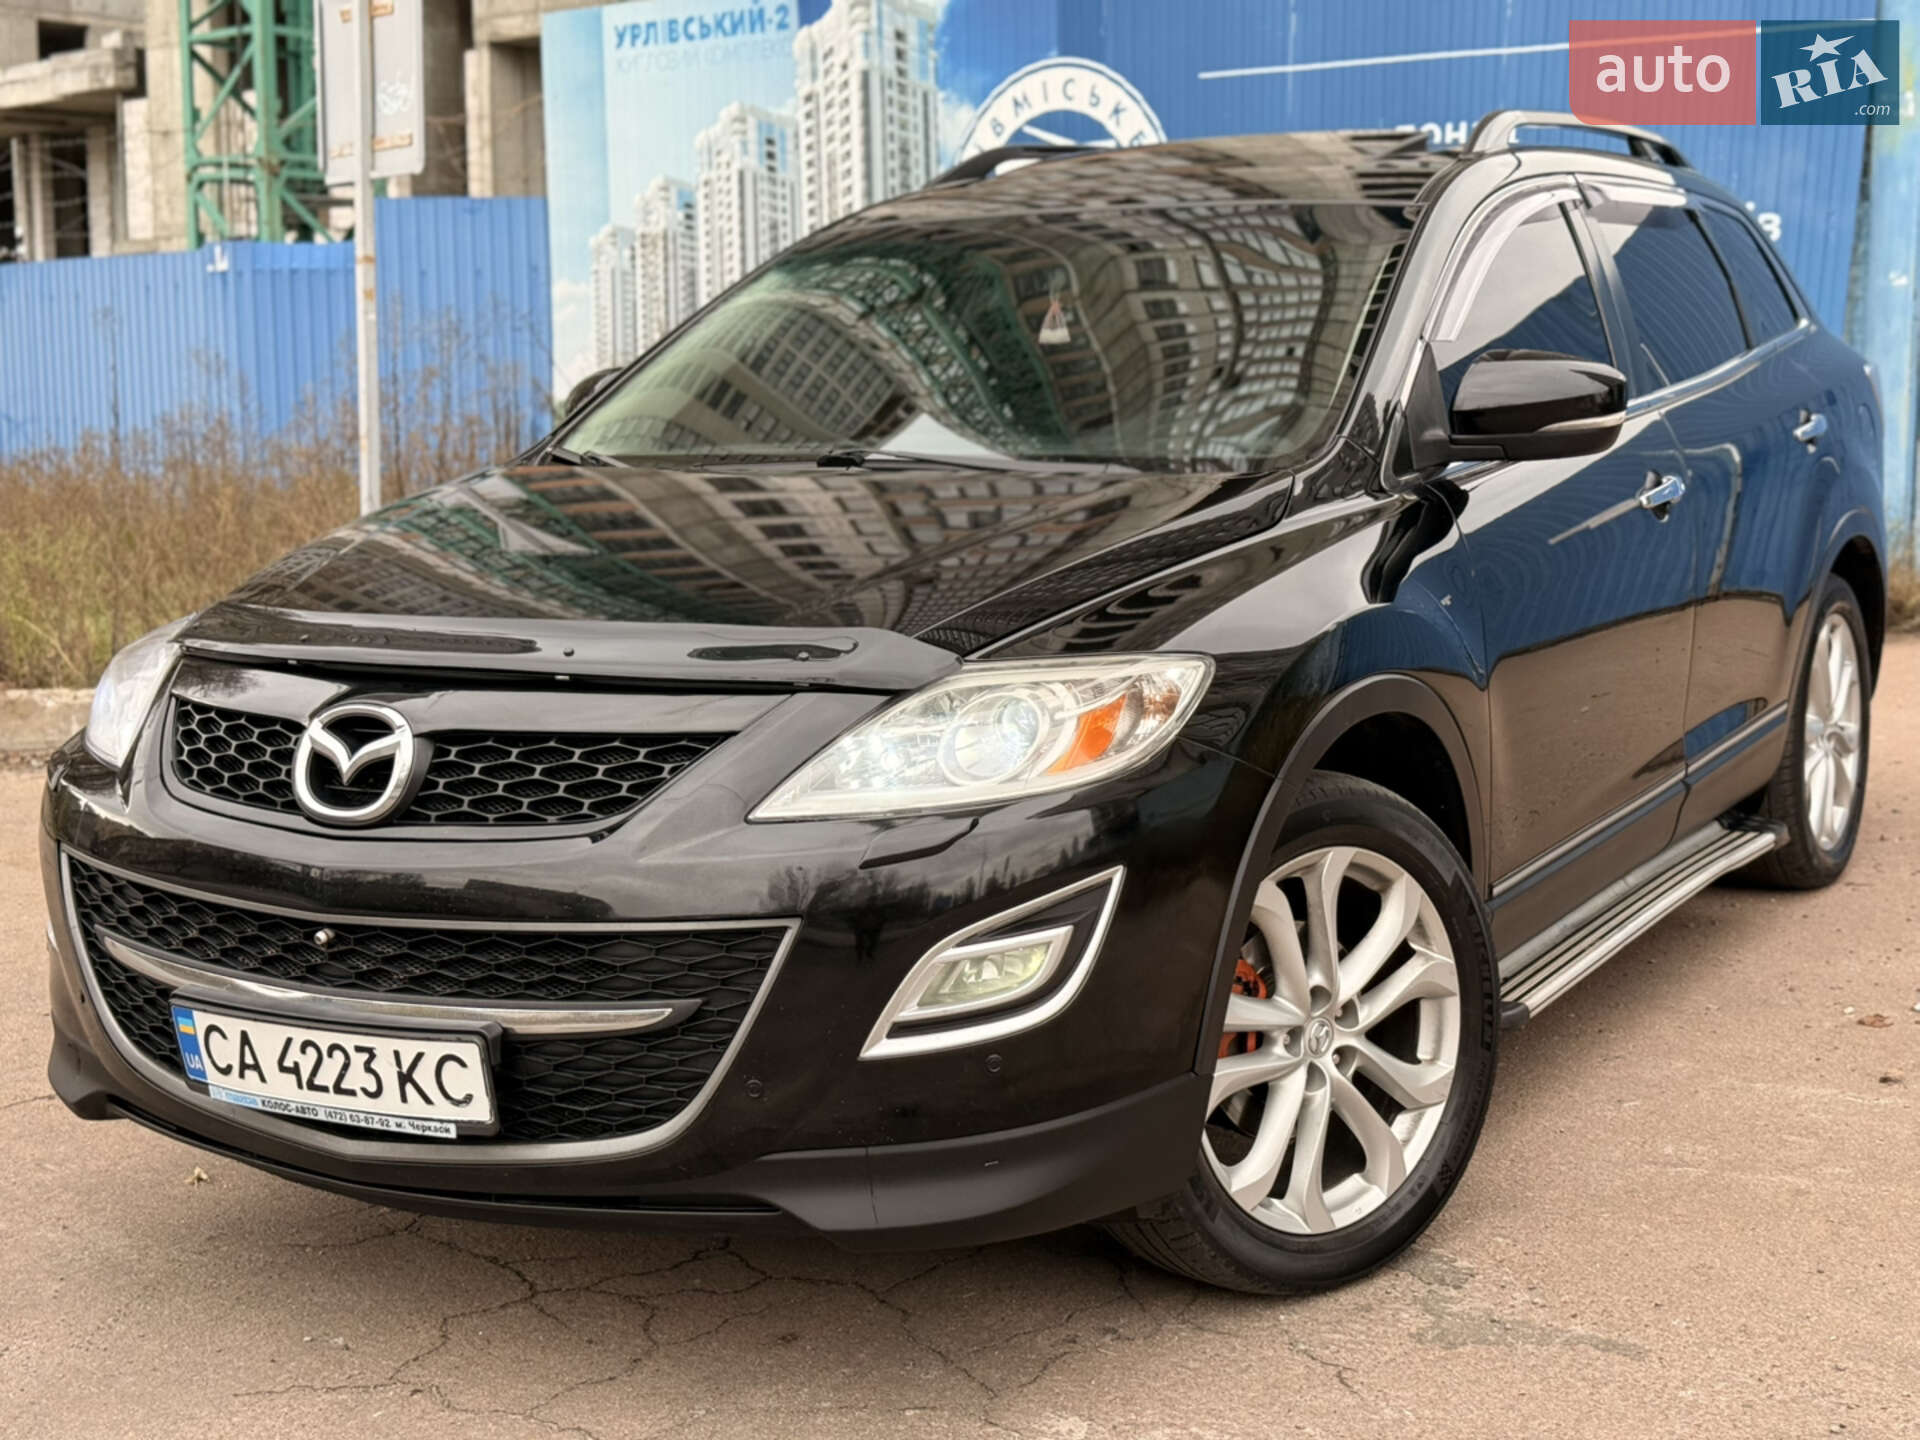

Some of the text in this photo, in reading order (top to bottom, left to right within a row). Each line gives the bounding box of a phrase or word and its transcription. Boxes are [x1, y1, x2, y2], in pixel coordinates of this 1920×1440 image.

[614, 0, 791, 49] УРЛВСЬКИЙ-2
[184, 1051, 204, 1072] UA
[203, 1023, 475, 1107] CA 4223 KC
